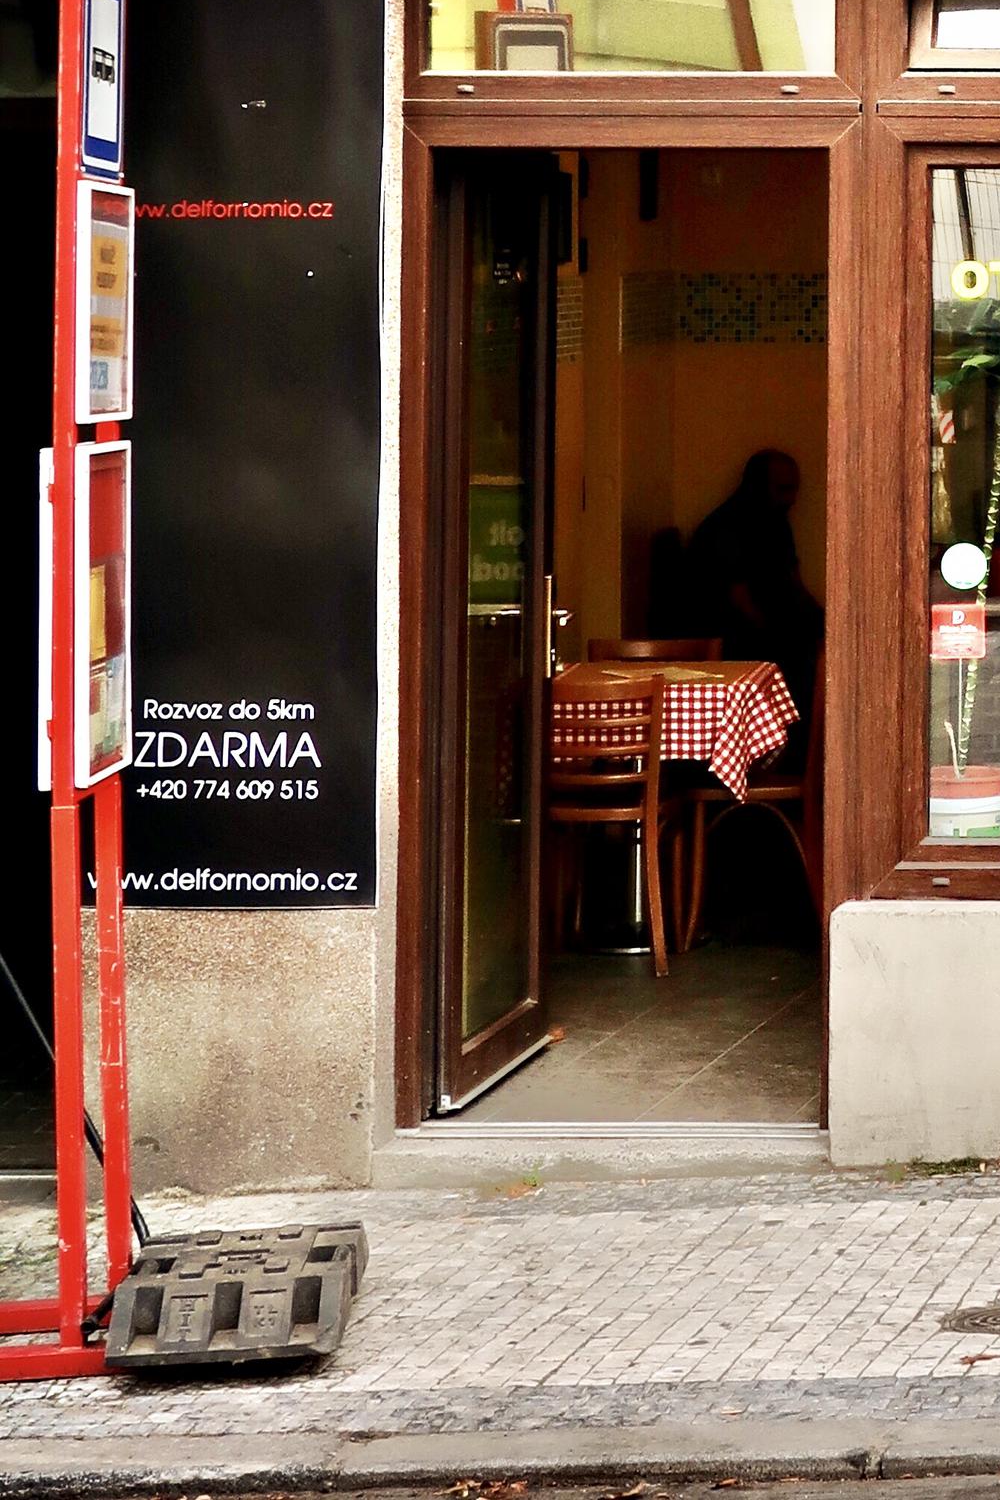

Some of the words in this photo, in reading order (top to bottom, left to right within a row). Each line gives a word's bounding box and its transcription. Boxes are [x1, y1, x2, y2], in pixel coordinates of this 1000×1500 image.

[135, 199, 333, 218] w.delfornomio.cz
[143, 699, 223, 720] Rozvoz
[228, 699, 261, 720] do
[266, 699, 315, 720] 5km
[134, 731, 322, 768] ZDARMA
[136, 780, 187, 799] +420
[193, 780, 230, 799] 774
[236, 780, 274, 799] 609
[280, 780, 319, 799] 515
